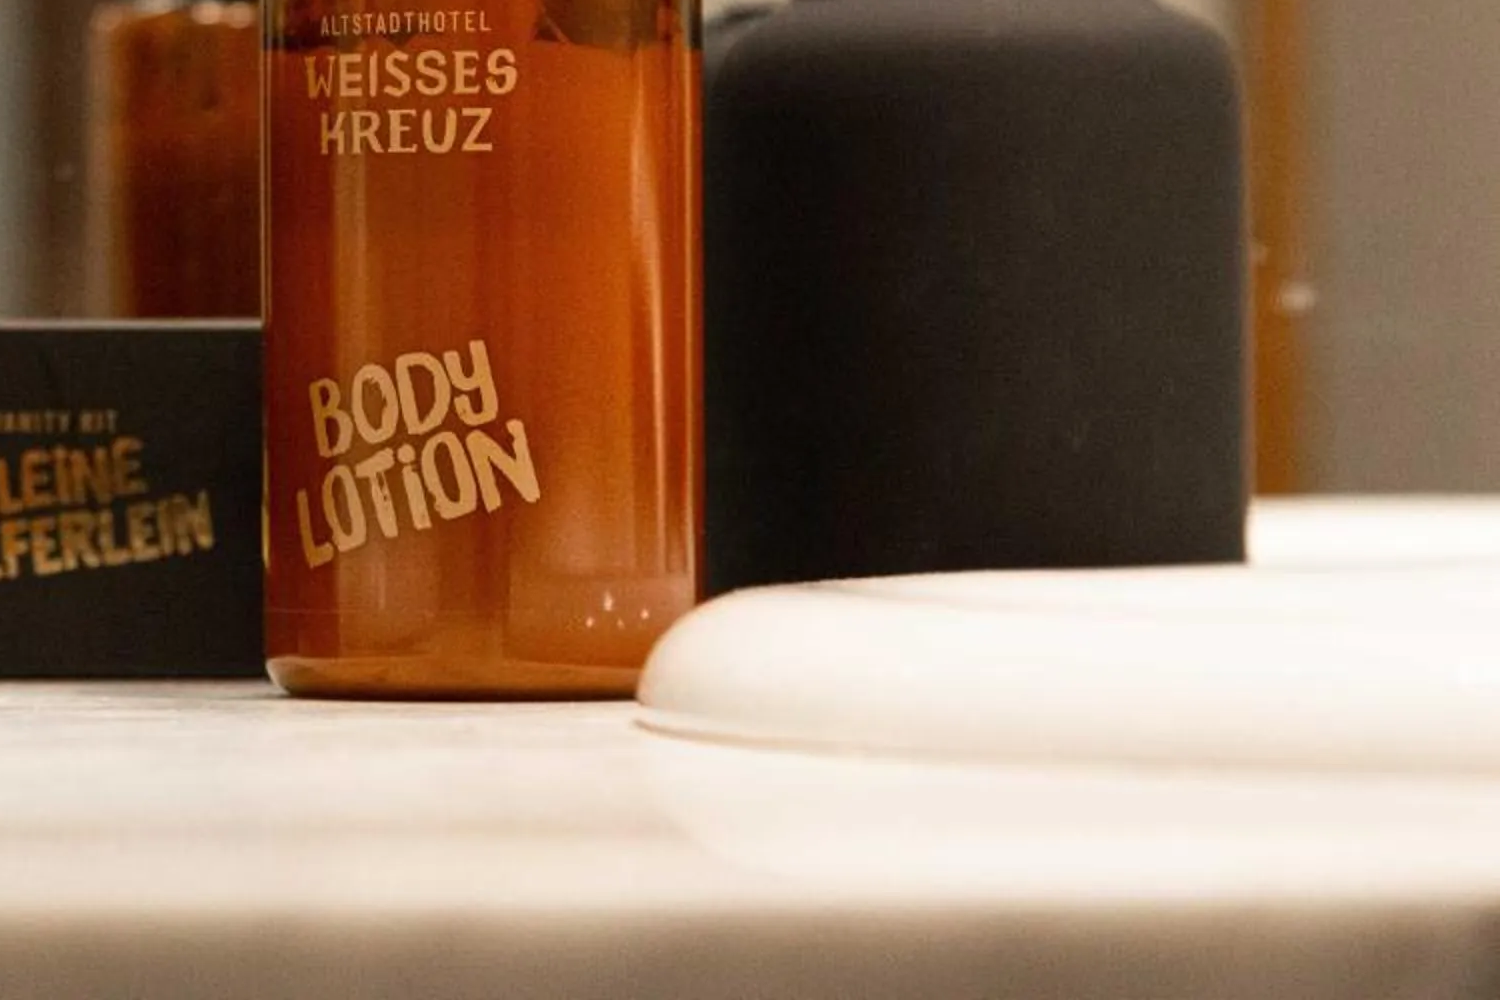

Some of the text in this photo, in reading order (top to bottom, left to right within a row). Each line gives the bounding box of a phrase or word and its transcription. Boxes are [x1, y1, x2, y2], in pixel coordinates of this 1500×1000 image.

[321, 10, 492, 37] ALTSTADTHOTEL
[304, 48, 518, 99] WEISSES
[319, 106, 493, 156] KREUZ
